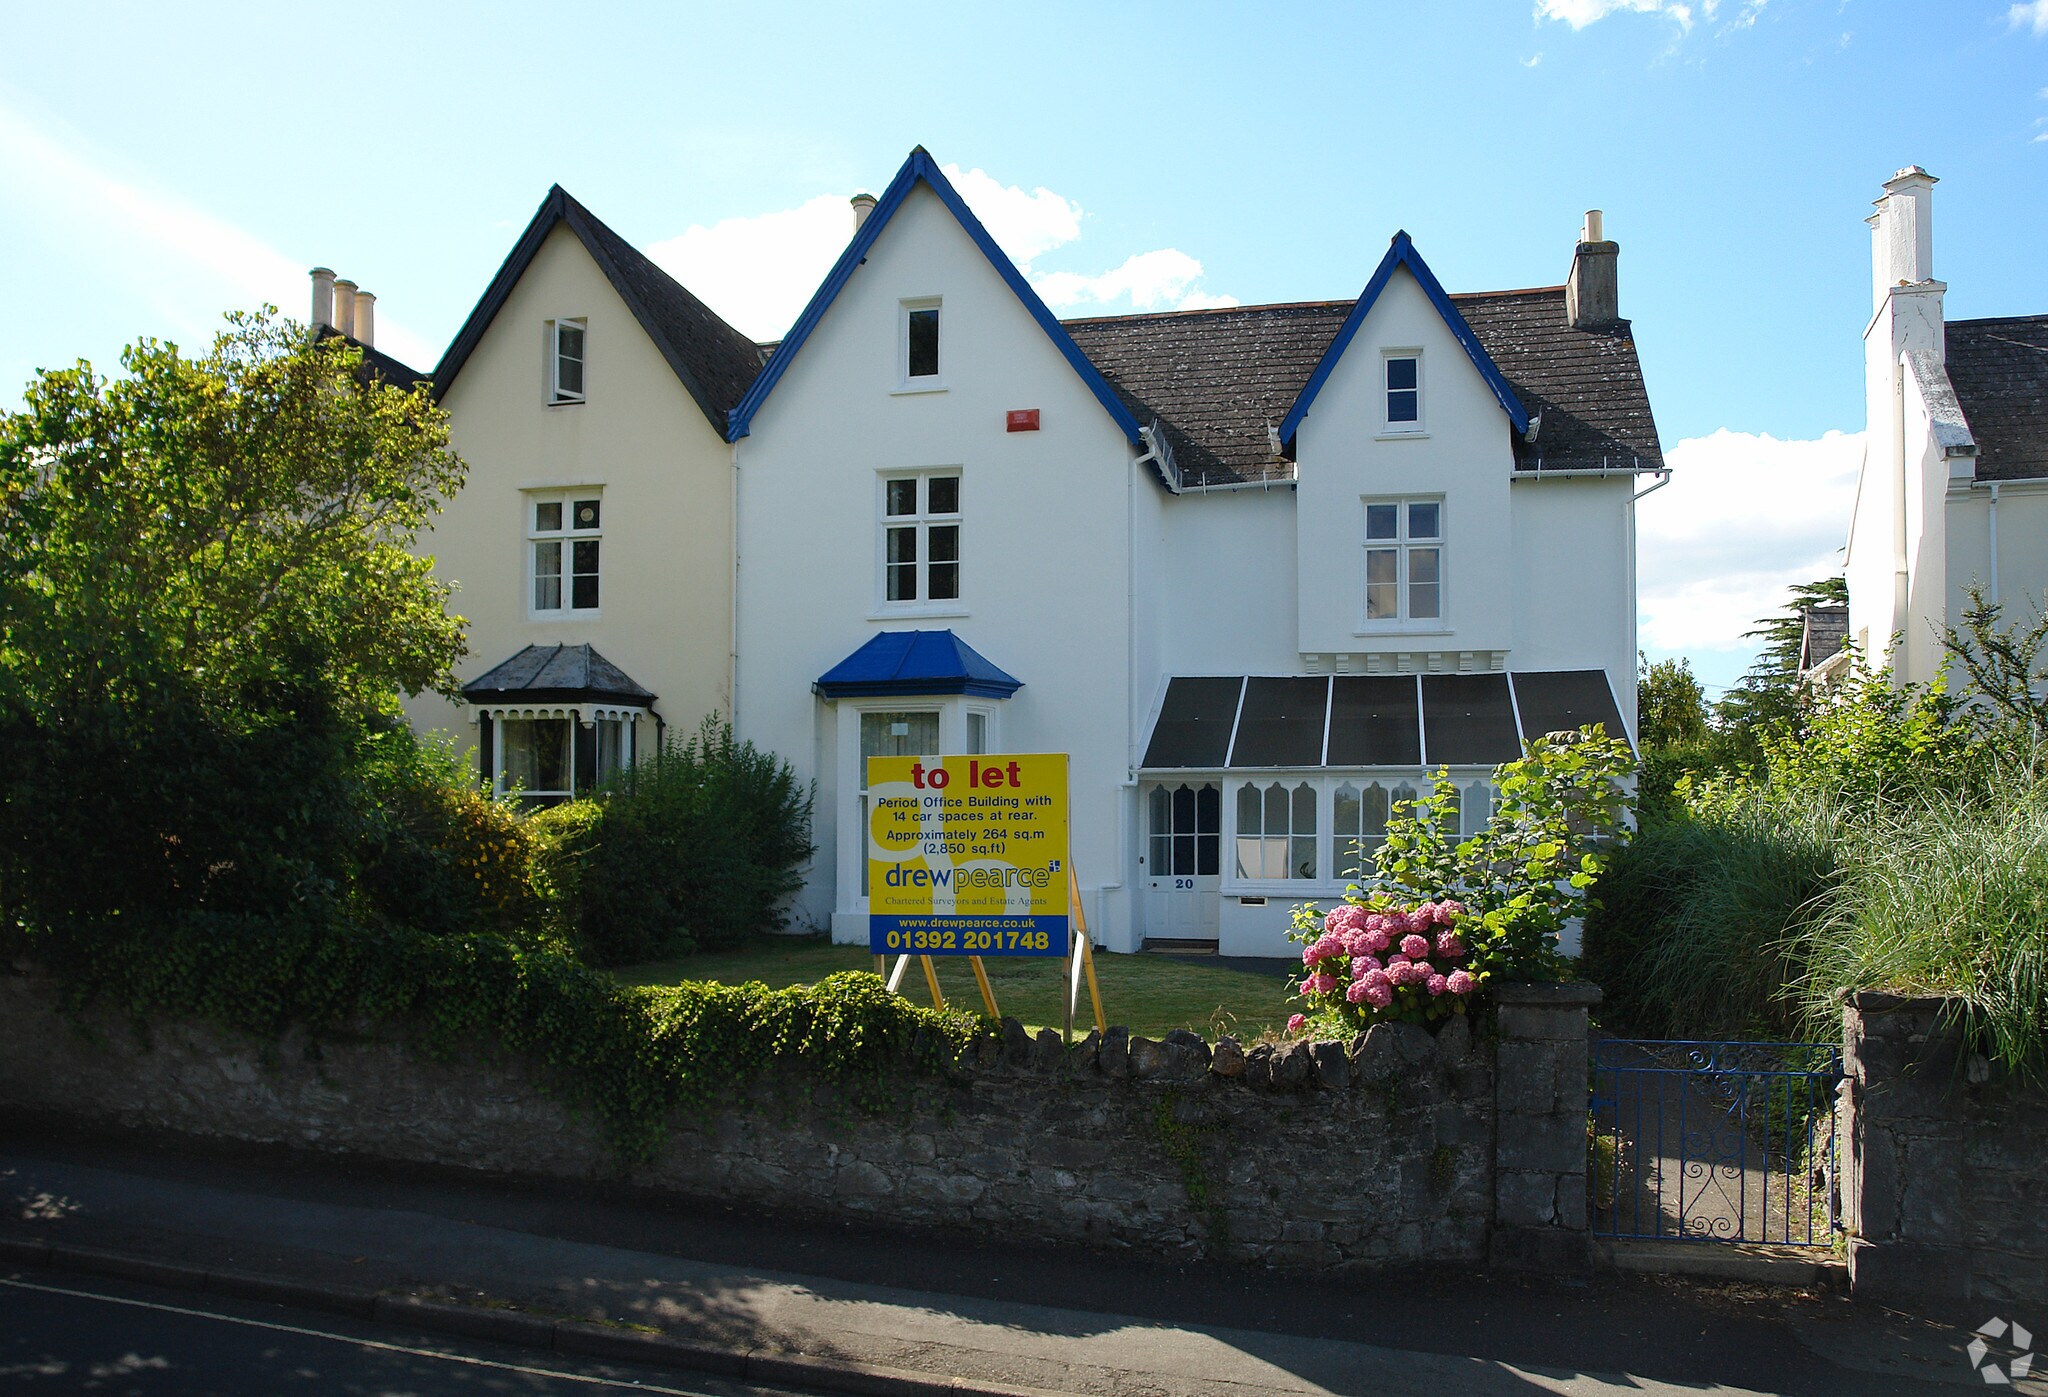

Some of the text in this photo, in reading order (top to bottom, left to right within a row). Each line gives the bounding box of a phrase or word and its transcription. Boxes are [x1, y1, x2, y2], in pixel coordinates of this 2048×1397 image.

[911, 760, 1021, 789] to let
[878, 795, 1052, 808] Period Office Building with
[893, 811, 1037, 823] 14 car spaces at rear.
[886, 828, 1045, 842] Approximately 264 sq.m
[923, 842, 1006, 855] (2,850 sq.ft)
[1175, 879, 1193, 889] 20
[885, 896, 1047, 907] Chartered Surveyors and Estate Agents
[899, 917, 1036, 929] www.drewpearce.co.uk
[886, 930, 1049, 950] 01392 201748
